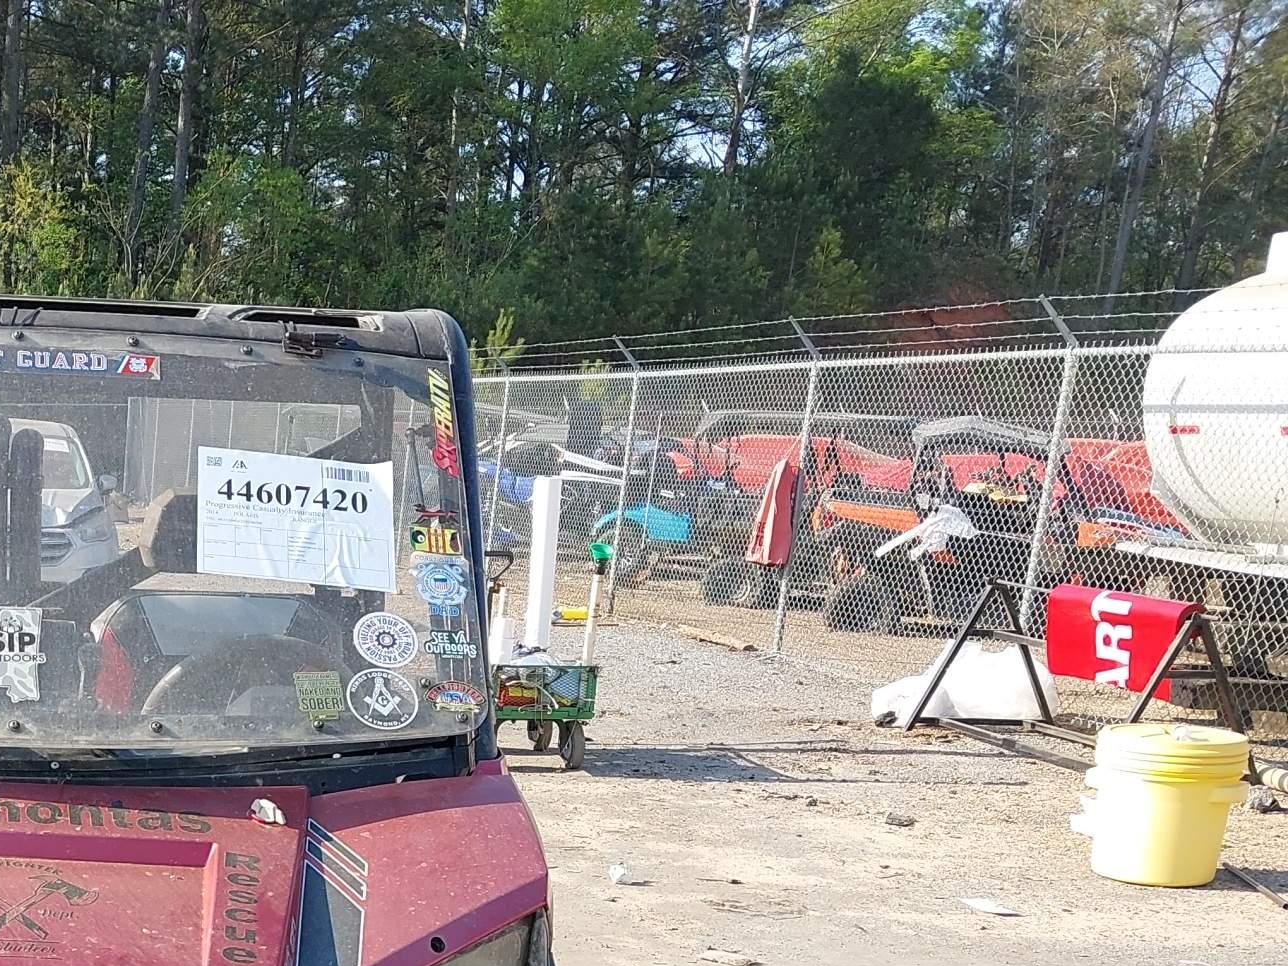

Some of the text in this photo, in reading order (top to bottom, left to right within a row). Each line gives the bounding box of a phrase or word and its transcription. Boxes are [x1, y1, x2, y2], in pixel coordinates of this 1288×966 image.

[16, 350, 108, 371] GUARD
[218, 478, 368, 514] 44607420
[205, 499, 251, 511] Progressive
[430, 604, 460, 616] DAD
[377, 618, 399, 628] YOUR
[432, 631, 468, 645] SEE YA
[366, 646, 398, 662] PASSION
[425, 643, 478, 658] OUTDOORS
[301, 697, 344, 710] SOBER!
[378, 696, 388, 705] G
[222, 851, 261, 964] Rescue
[41, 908, 80, 921] Dept.
